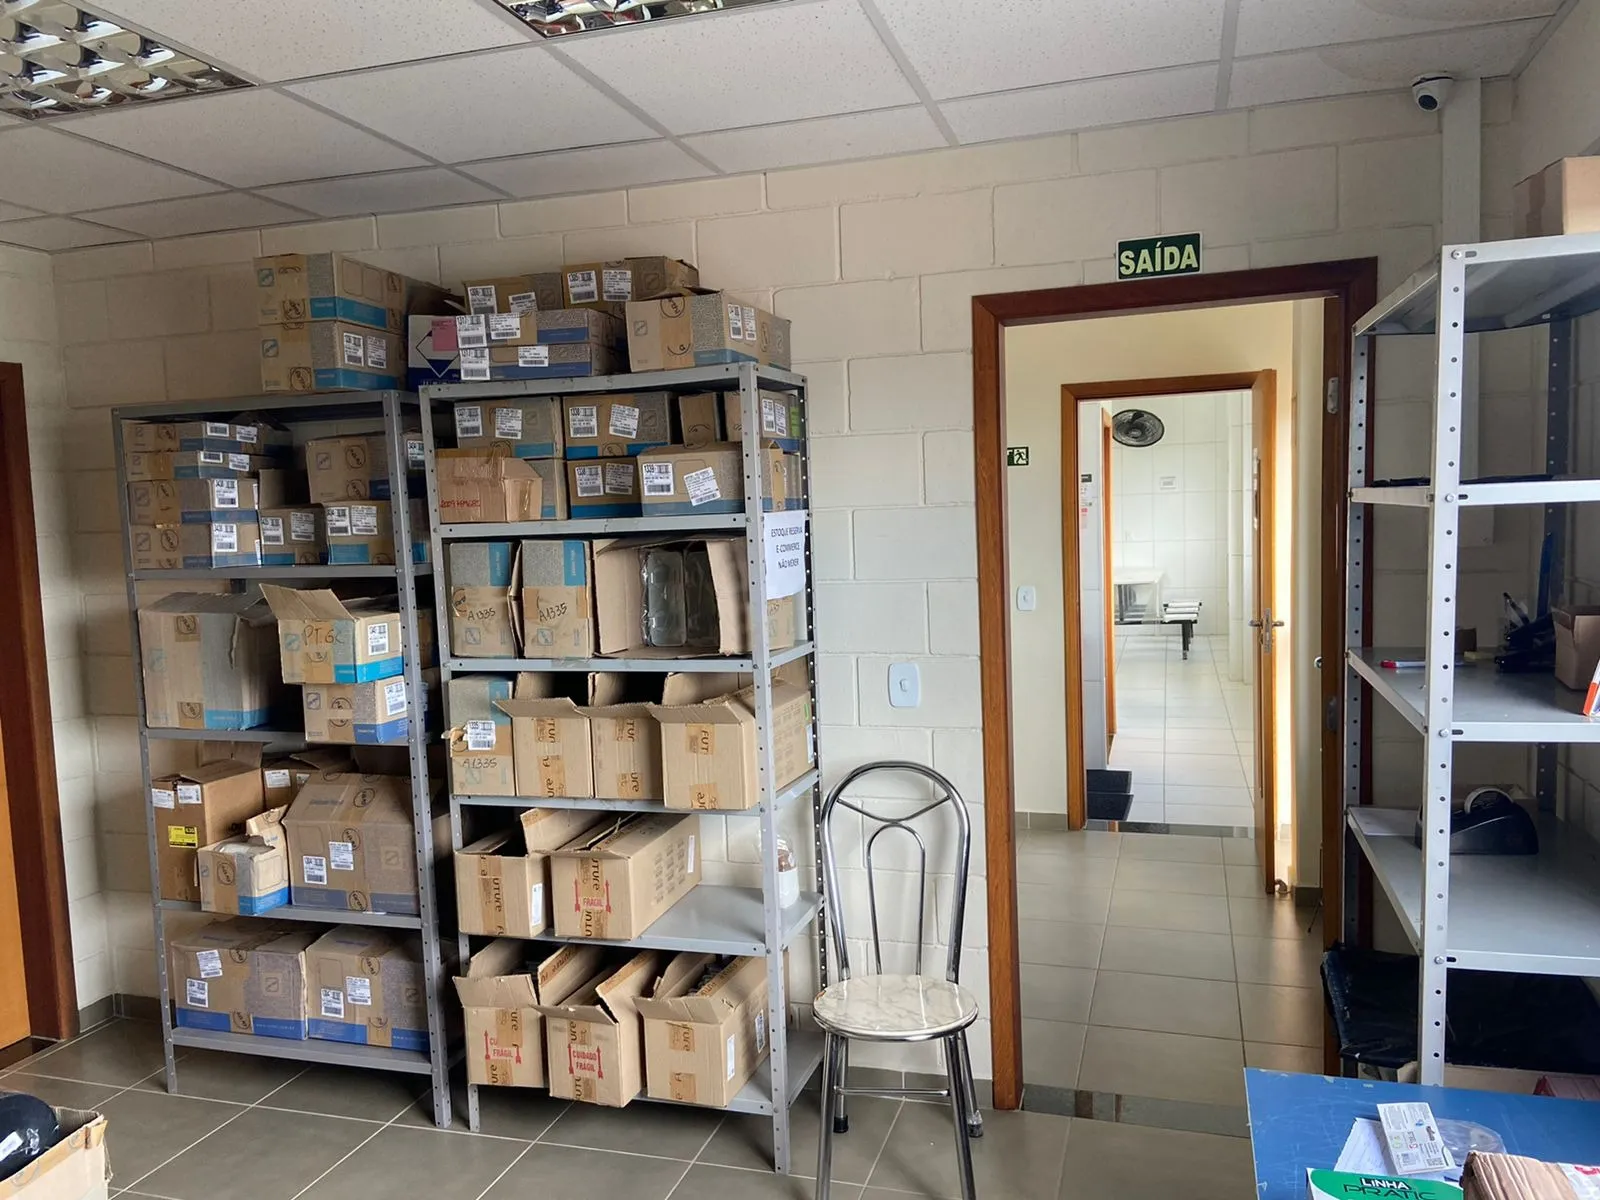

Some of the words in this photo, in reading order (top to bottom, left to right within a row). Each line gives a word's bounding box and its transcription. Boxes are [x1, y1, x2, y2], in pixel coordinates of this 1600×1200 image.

[1120, 241, 1198, 275] SAÍDA
[771, 528, 788, 537] ESTOQUE
[776, 542, 800, 553] E-COMMERCE
[778, 558, 787, 568] NÃO
[538, 602, 568, 622] A1335
[462, 757, 498, 769] A1335
[572, 1050, 597, 1061] CUIDADO
[1361, 1178, 1410, 1191] LINHA
[1343, 1184, 1436, 1200] PRATIC
